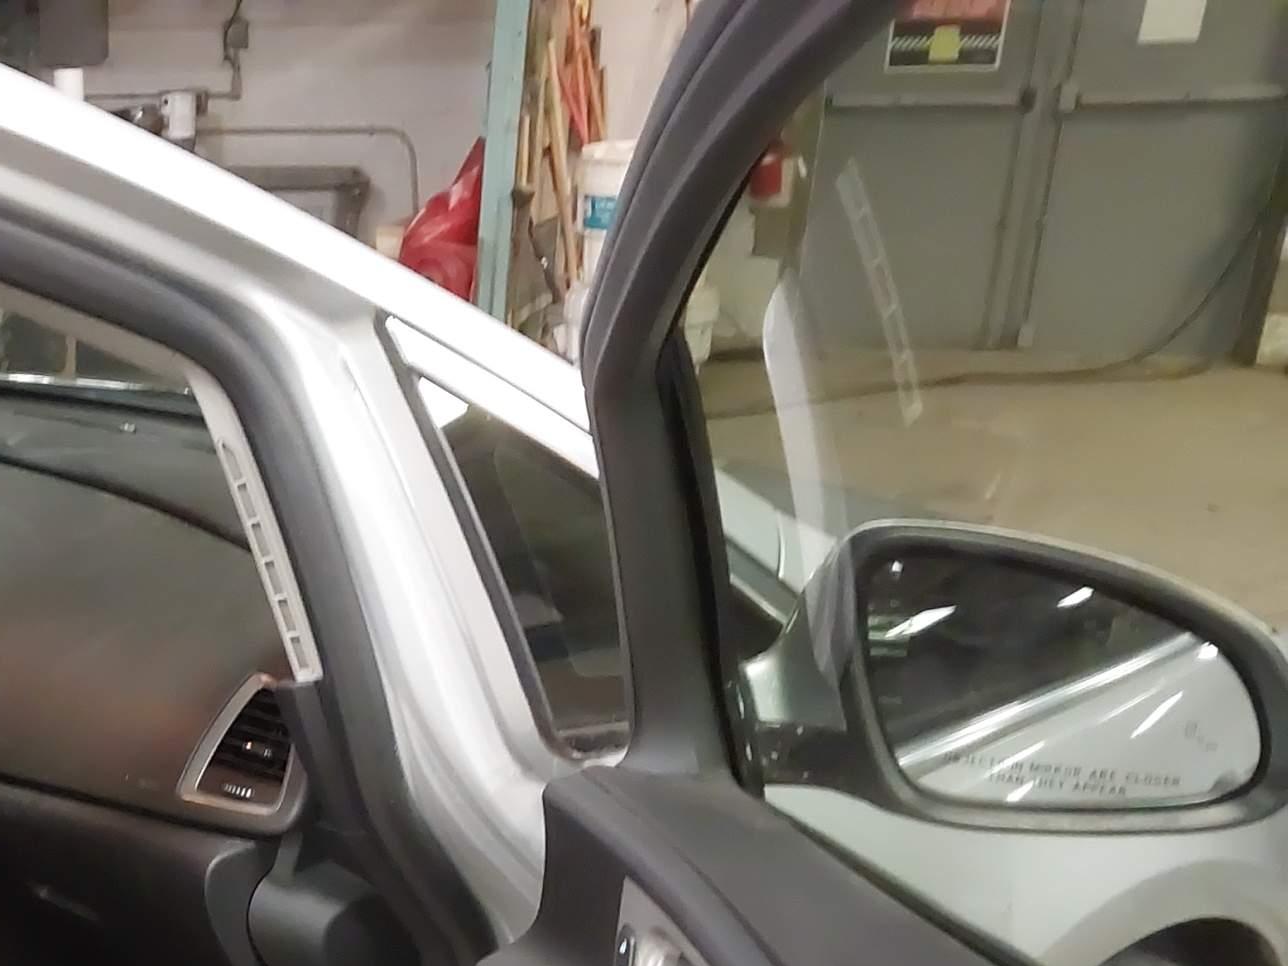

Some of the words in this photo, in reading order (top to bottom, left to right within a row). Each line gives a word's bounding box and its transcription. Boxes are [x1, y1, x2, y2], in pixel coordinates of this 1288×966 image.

[943, 751, 1003, 770] OBJECT
[1089, 767, 1115, 781] ARE
[1125, 770, 1182, 787] CLOSER
[1033, 777, 1064, 791] HEY
